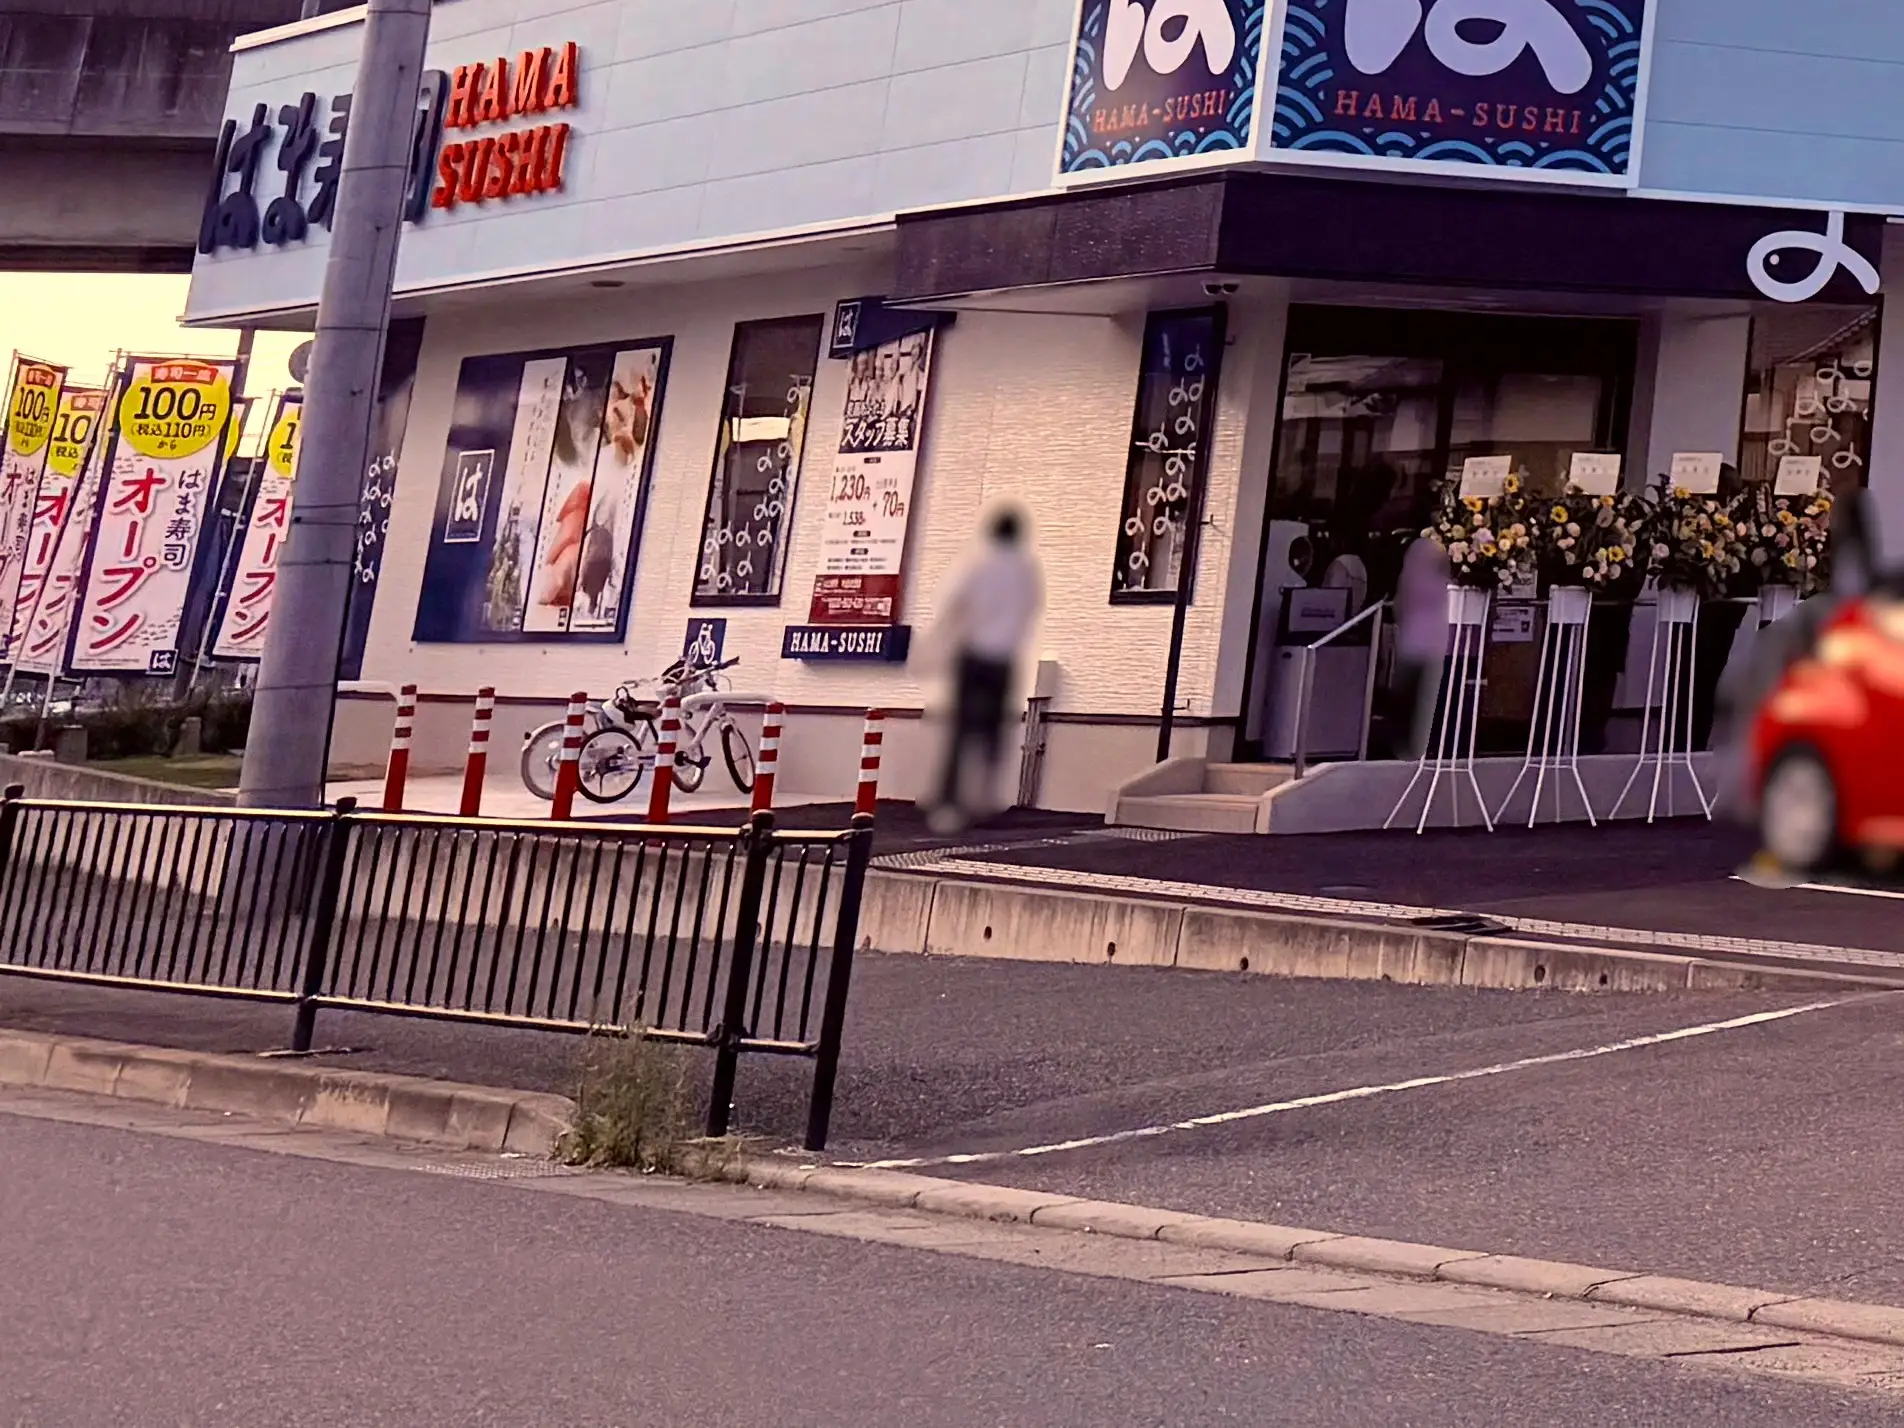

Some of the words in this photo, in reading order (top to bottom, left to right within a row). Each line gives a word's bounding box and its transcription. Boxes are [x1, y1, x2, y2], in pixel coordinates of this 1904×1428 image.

[444, 41, 580, 129] HAMA
[1093, 89, 1229, 133] HAMA-SUSHI
[1333, 89, 1584, 135] HAMA-SUSHI
[432, 122, 571, 208] SUSHI
[134, 387, 217, 421] 100円
[164, 469, 202, 567] はま寿司
[455, 462, 483, 522] は
[90, 468, 167, 650] オープン
[790, 631, 884, 654] HAMA-SUSHI
